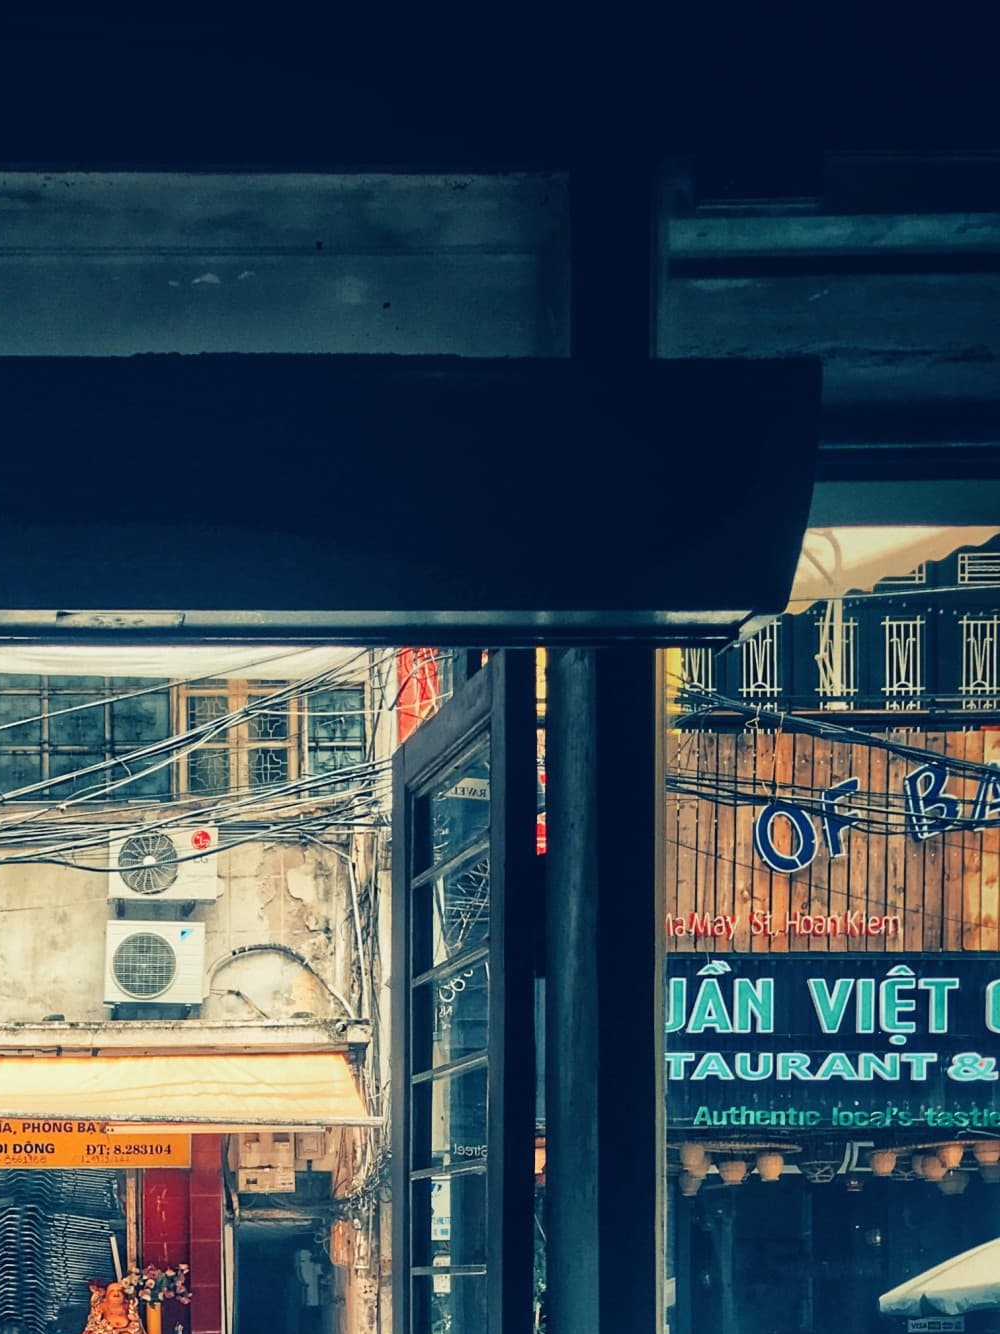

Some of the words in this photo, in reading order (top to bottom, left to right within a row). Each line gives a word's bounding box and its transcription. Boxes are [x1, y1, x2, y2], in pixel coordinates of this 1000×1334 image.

[754, 777, 860, 874] OF
[786, 912, 840, 936] Hoan
[807, 964, 960, 1045] VIỆT
[665, 1052, 938, 1081] TAURANT
[947, 1052, 999, 1082] &
[693, 1105, 820, 1127] Authentic
[86, 1144, 111, 1156] ĐT:
[113, 1144, 172, 1156] 8.283104
